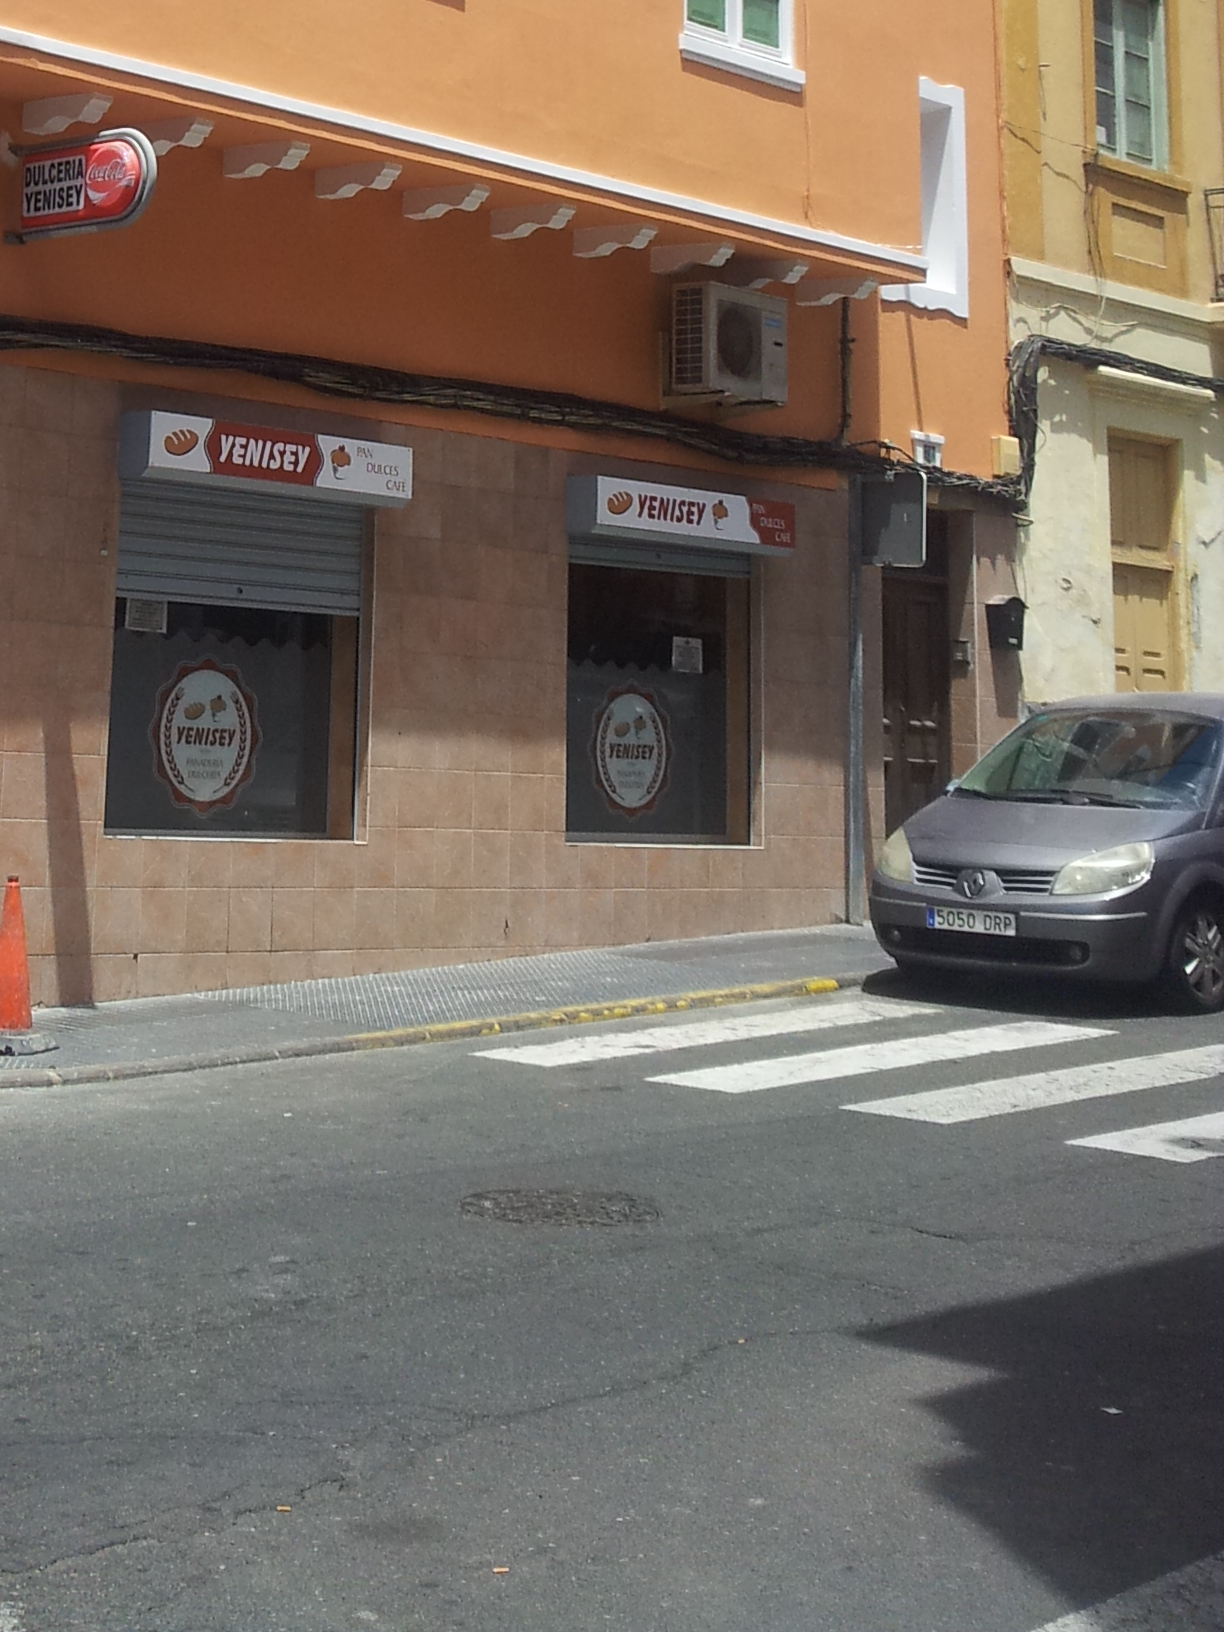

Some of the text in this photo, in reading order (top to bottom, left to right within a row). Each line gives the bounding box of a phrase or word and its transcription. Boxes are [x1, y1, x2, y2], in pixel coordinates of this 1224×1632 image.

[25, 158, 84, 188] DULCERIA
[25, 183, 84, 214] YENISEY
[219, 433, 311, 474] YENISEY
[356, 446, 374, 459] PAN
[366, 462, 400, 477] DULCES
[637, 493, 707, 526] YENISEY
[176, 726, 237, 747] YENISEY
[609, 742, 655, 760] YENISEY
[936, 909, 1012, 933] 5050 DRP
